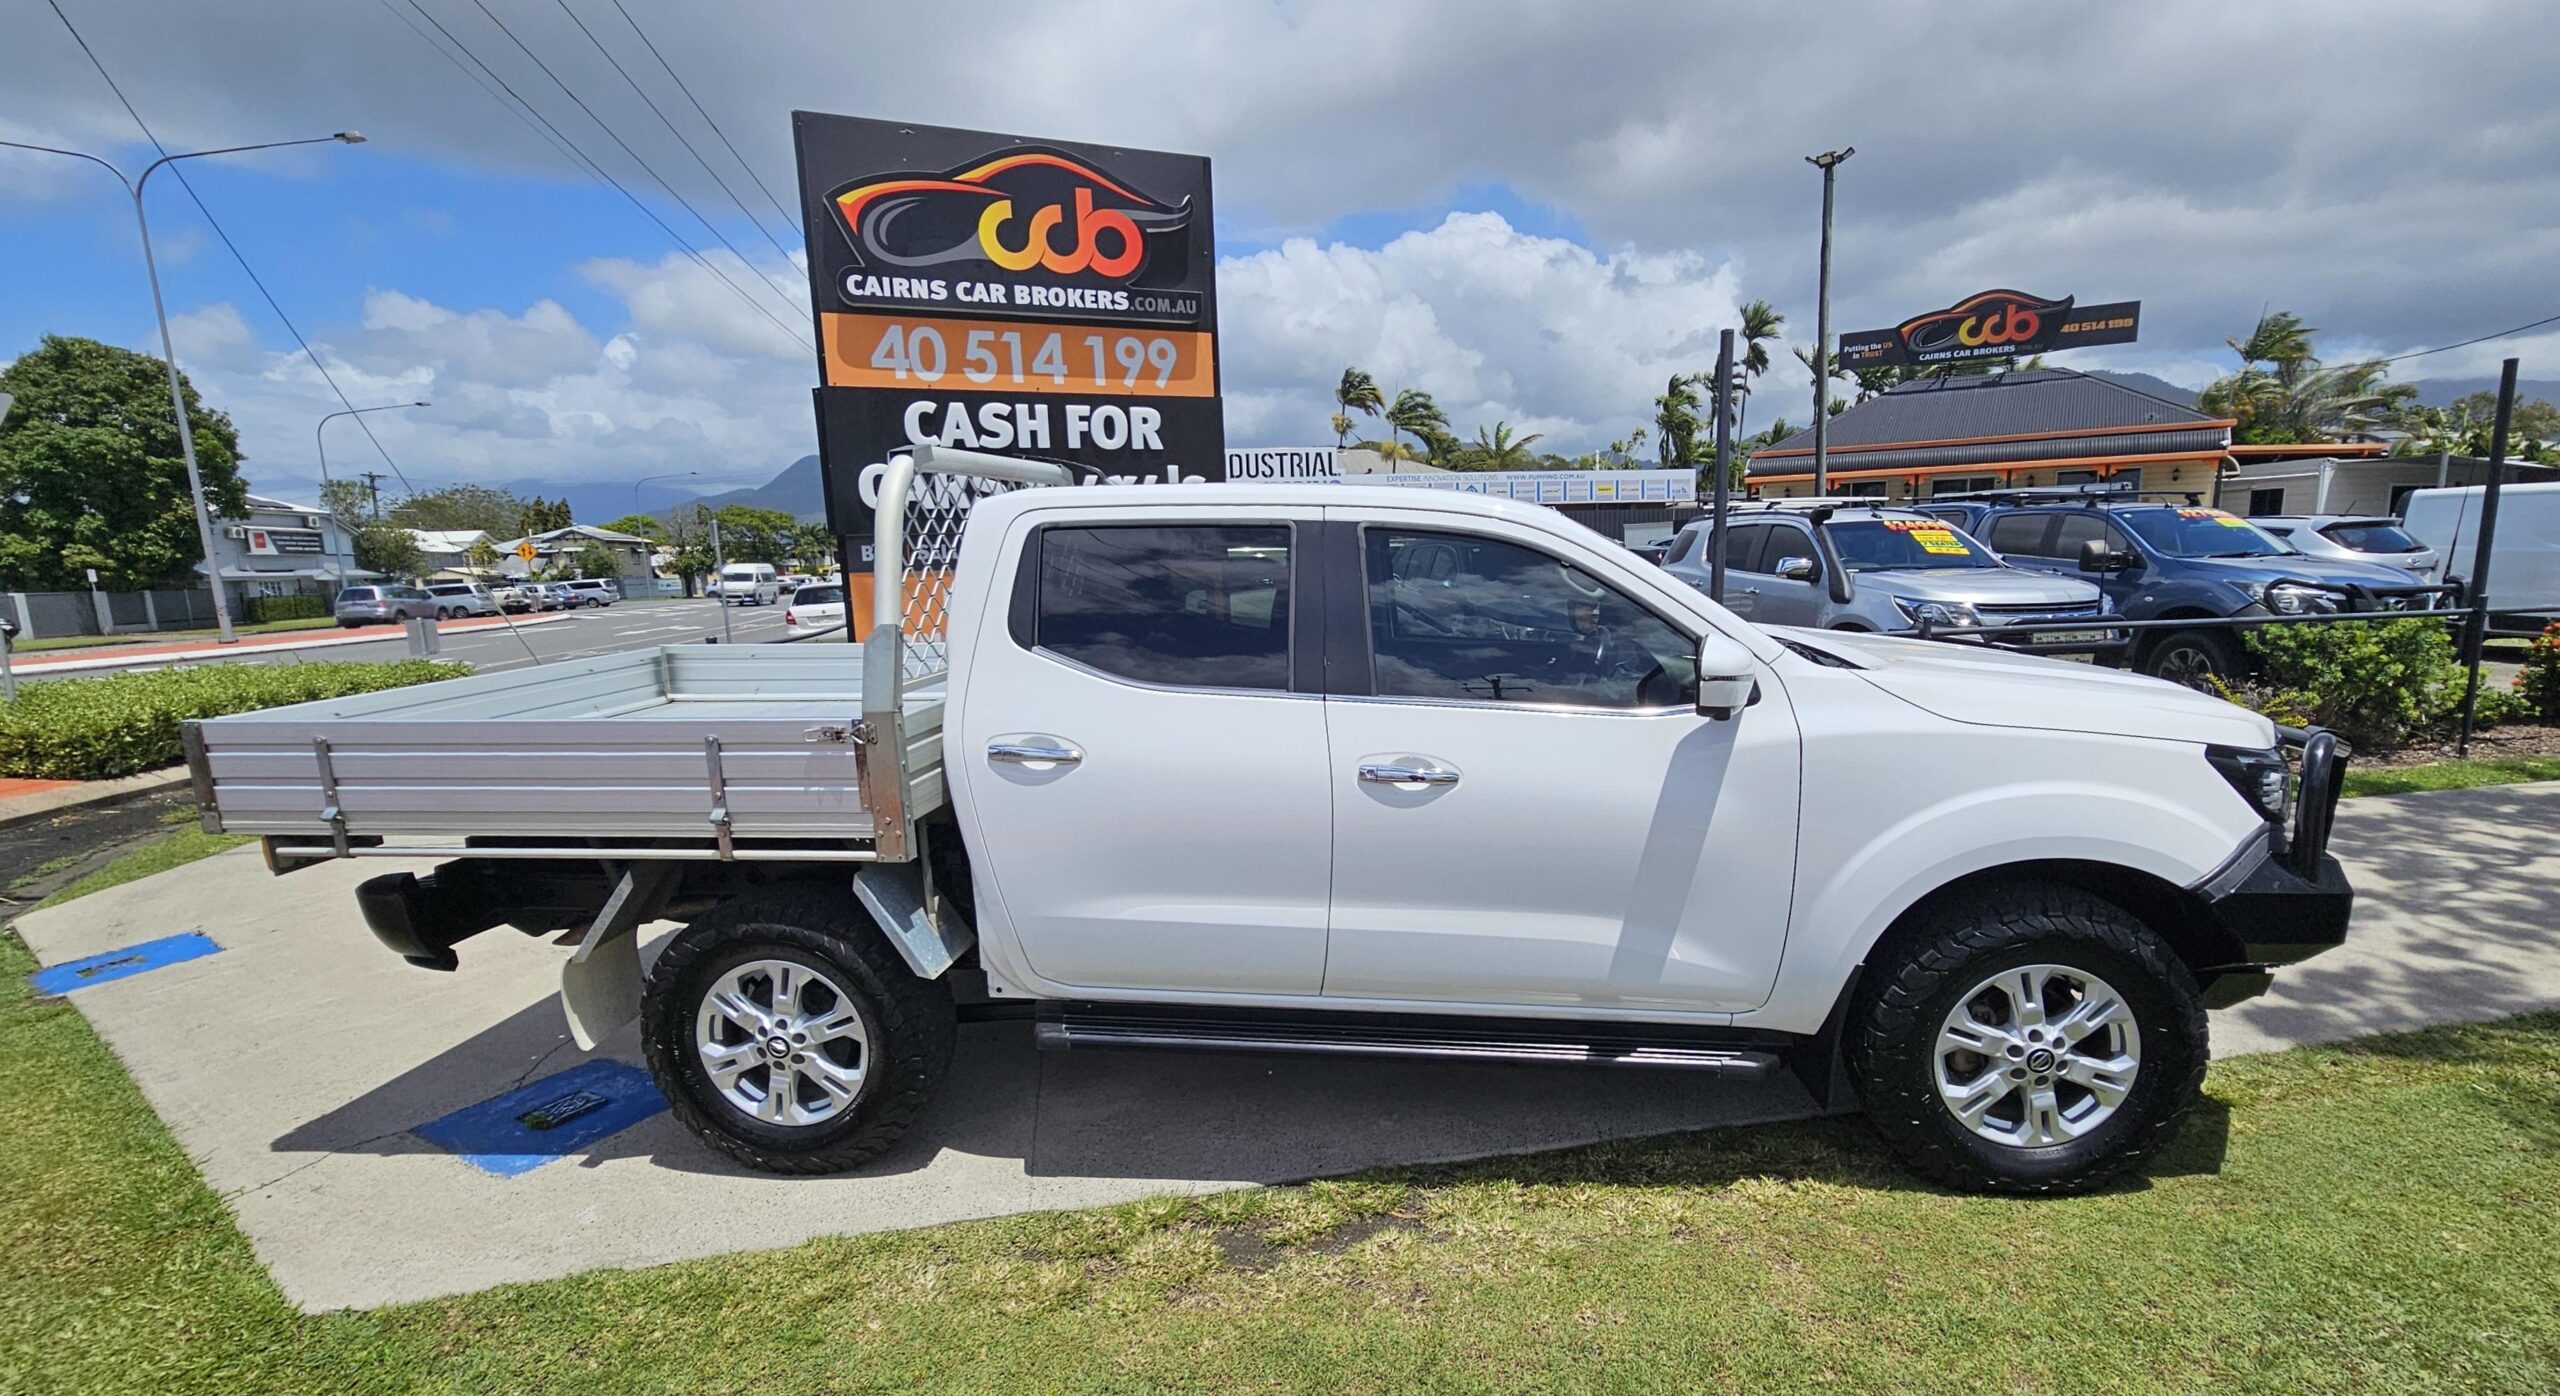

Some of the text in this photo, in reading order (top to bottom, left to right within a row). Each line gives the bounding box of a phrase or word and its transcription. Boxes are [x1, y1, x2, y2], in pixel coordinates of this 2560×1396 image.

[846, 274, 947, 301] CAIRNS
[955, 281, 1006, 303] CAR
[2060, 323, 2079, 333] 40
[2081, 320, 2105, 332] 514
[1844, 344, 1869, 353] Putting
[1870, 342, 1882, 350] the
[870, 325, 1177, 389] 40 514 199
[1861, 350, 1883, 359] TRUST
[1919, 351, 1952, 361] CAIRNS
[1953, 349, 1971, 358] CAR
[904, 400, 1164, 450] CASH FOR
[1386, 475, 1422, 483] EXPERTISE
[1423, 474, 1462, 482] INNOVATION
[1506, 473, 1586, 481] WWW.PUMPING.COM.AU
